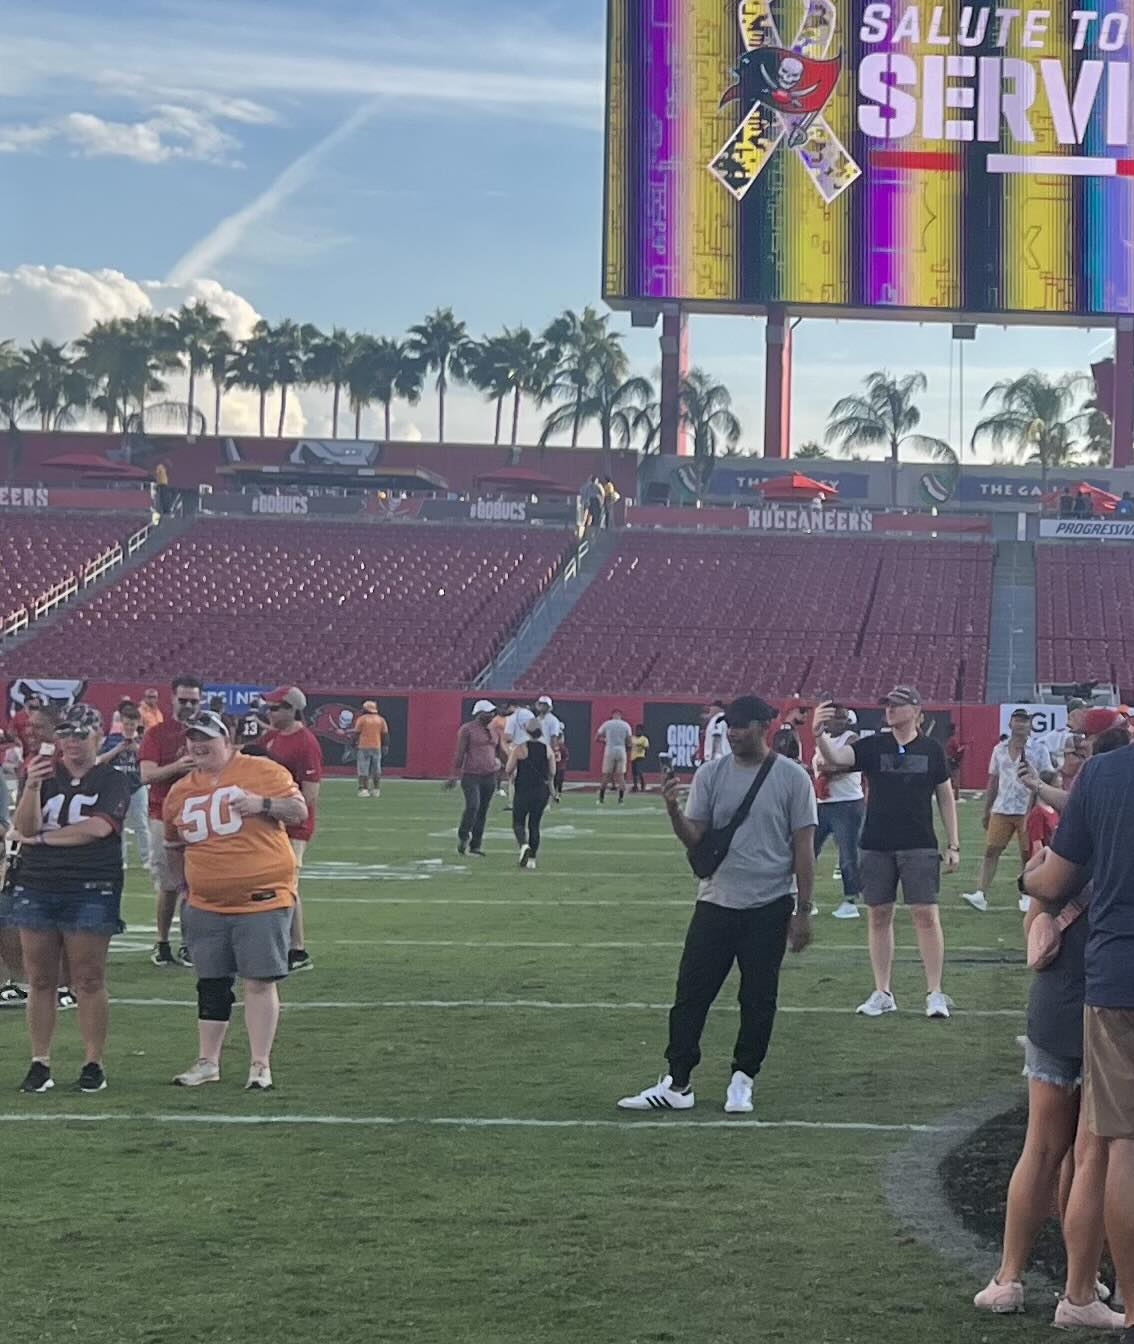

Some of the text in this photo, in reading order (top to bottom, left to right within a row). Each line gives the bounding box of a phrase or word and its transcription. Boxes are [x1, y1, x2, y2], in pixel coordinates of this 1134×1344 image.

[860, 2, 1130, 52] SALUTE TO
[980, 484, 1012, 496] THE
[252, 495, 309, 514] #GOBUCS
[470, 501, 526, 521] #GOBUCS
[749, 509, 872, 532] BUCCANEERS
[243, 721, 258, 735] 13
[181, 785, 243, 844] 50
